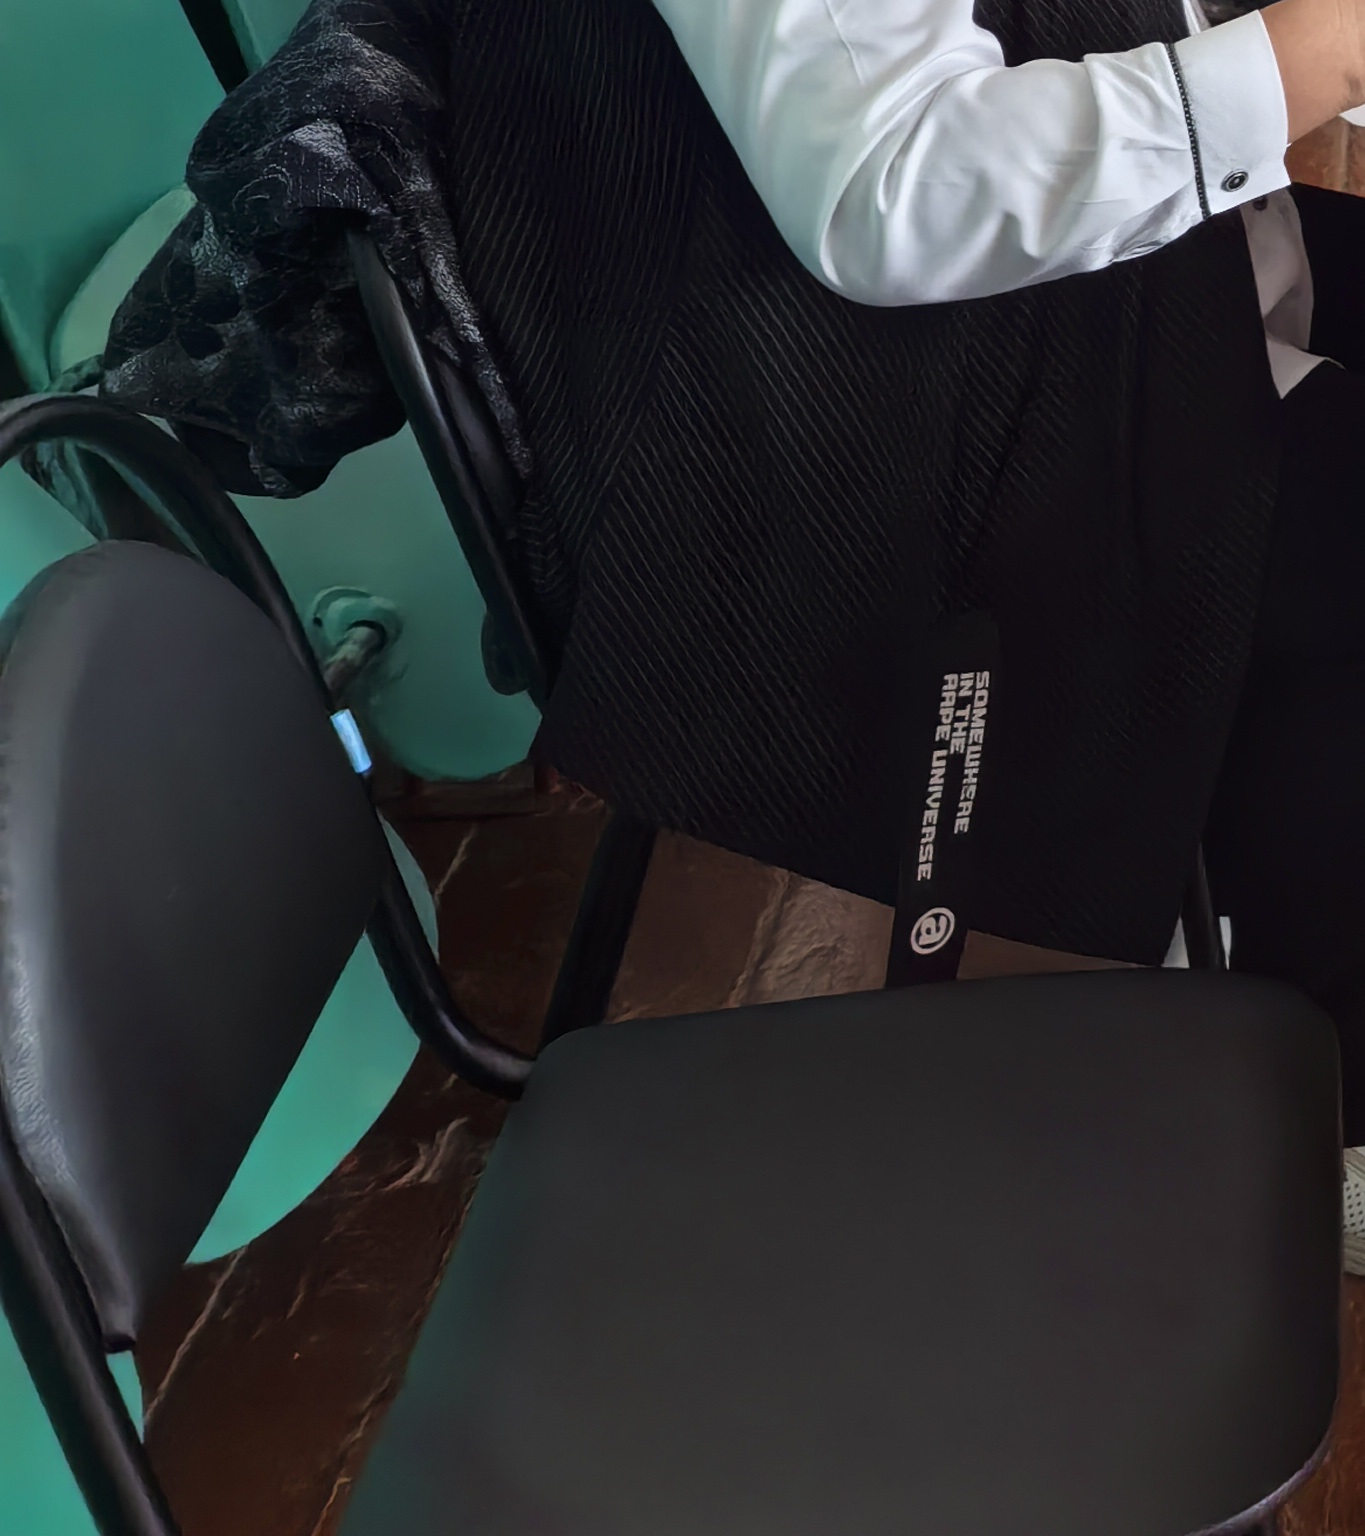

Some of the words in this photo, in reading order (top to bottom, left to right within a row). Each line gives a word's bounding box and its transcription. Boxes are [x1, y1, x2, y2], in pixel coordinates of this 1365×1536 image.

[950, 704, 972, 754] THE
[959, 672, 975, 697] IN
[953, 670, 991, 835] SOMEWHERE
[917, 750, 947, 882] UNIVERSE
